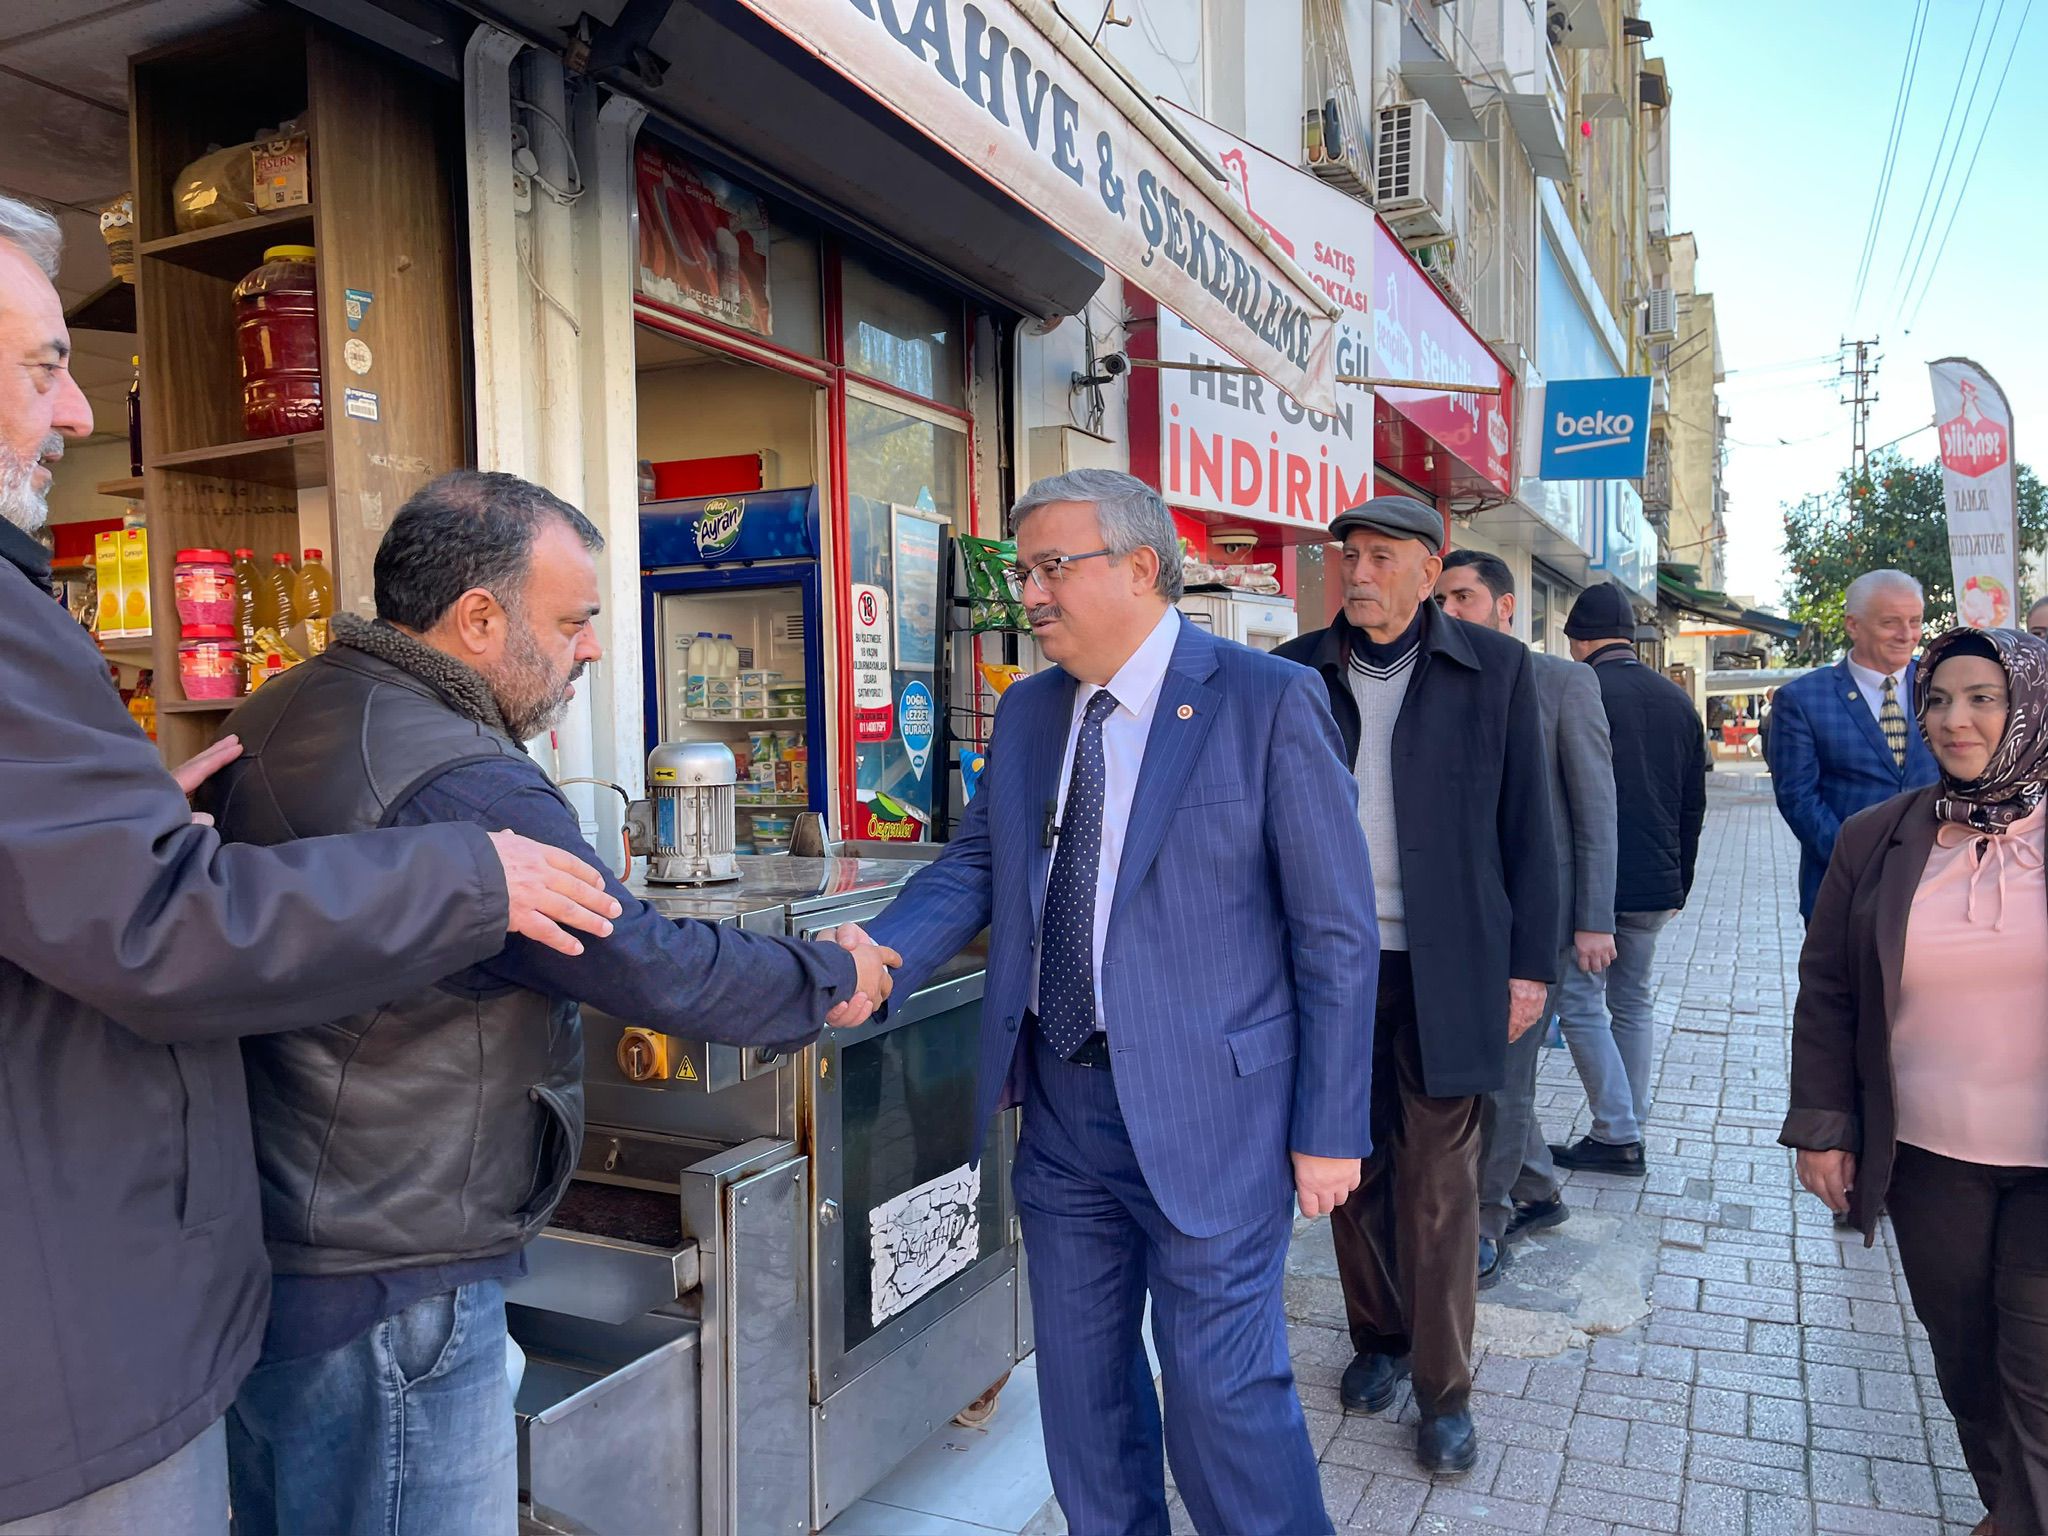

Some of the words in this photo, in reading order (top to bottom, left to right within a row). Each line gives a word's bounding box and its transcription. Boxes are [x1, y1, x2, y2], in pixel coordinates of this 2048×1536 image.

[1097, 131, 1126, 221] &
[1138, 169, 1312, 374] ŞEKERLEME
[1314, 241, 1356, 283] SATIŞ
[1189, 353, 1265, 415] HER
[1556, 410, 1635, 437] beko
[1169, 403, 1368, 525] İNDİRİM
[701, 508, 738, 543] Ayran
[863, 596, 873, 618] 18
[906, 692, 929, 705] DOĞAL
[904, 723, 932, 736] BURADA
[905, 709, 929, 721] LEZZET
[867, 813, 915, 843] Özgenler
